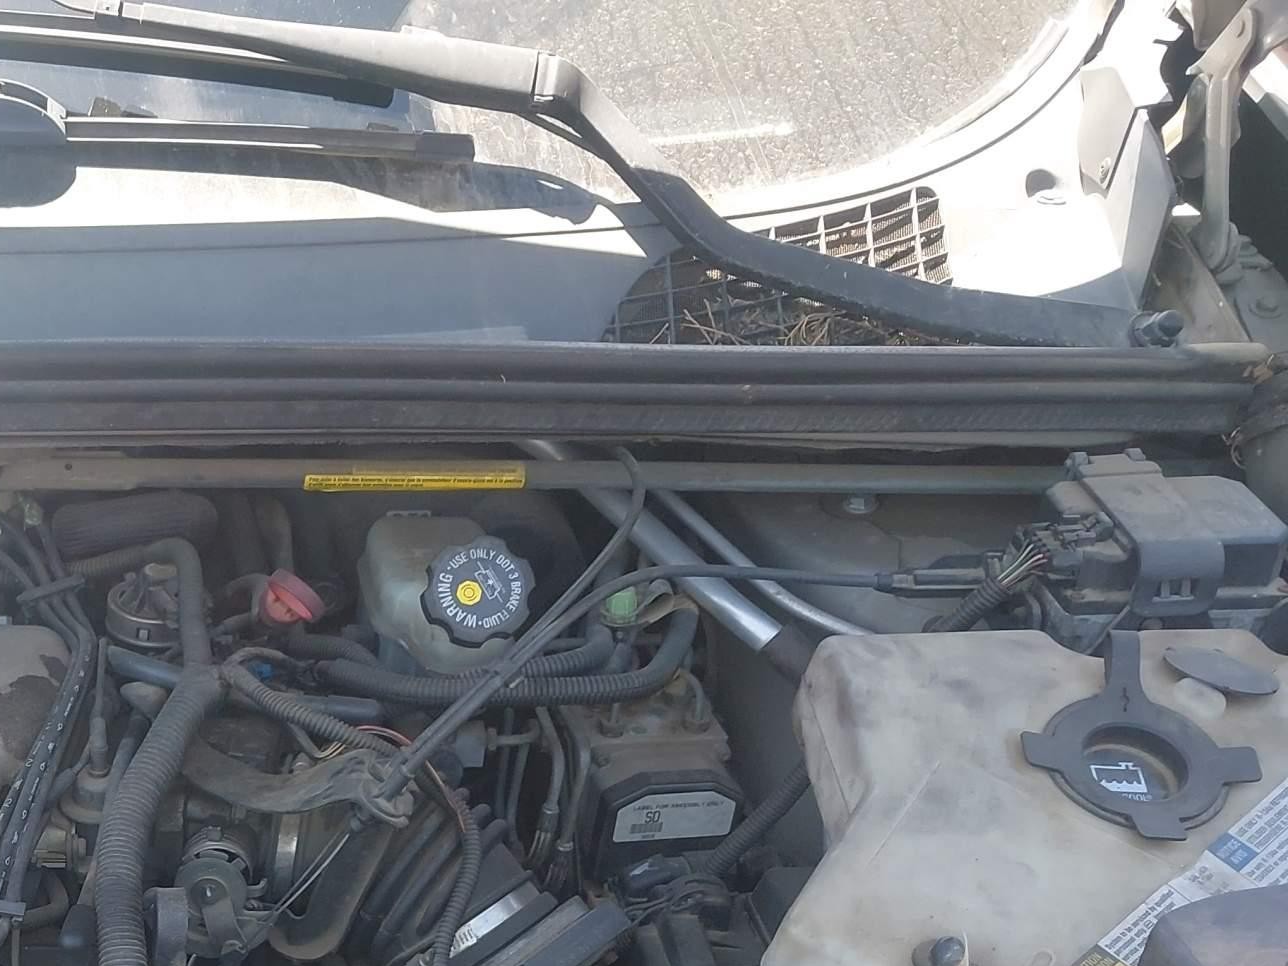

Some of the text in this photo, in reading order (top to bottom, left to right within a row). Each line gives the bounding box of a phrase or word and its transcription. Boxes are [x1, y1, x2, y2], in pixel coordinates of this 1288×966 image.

[437, 548, 522, 629] WARNING USE ONLY DOT 3 BRAKE FLUID
